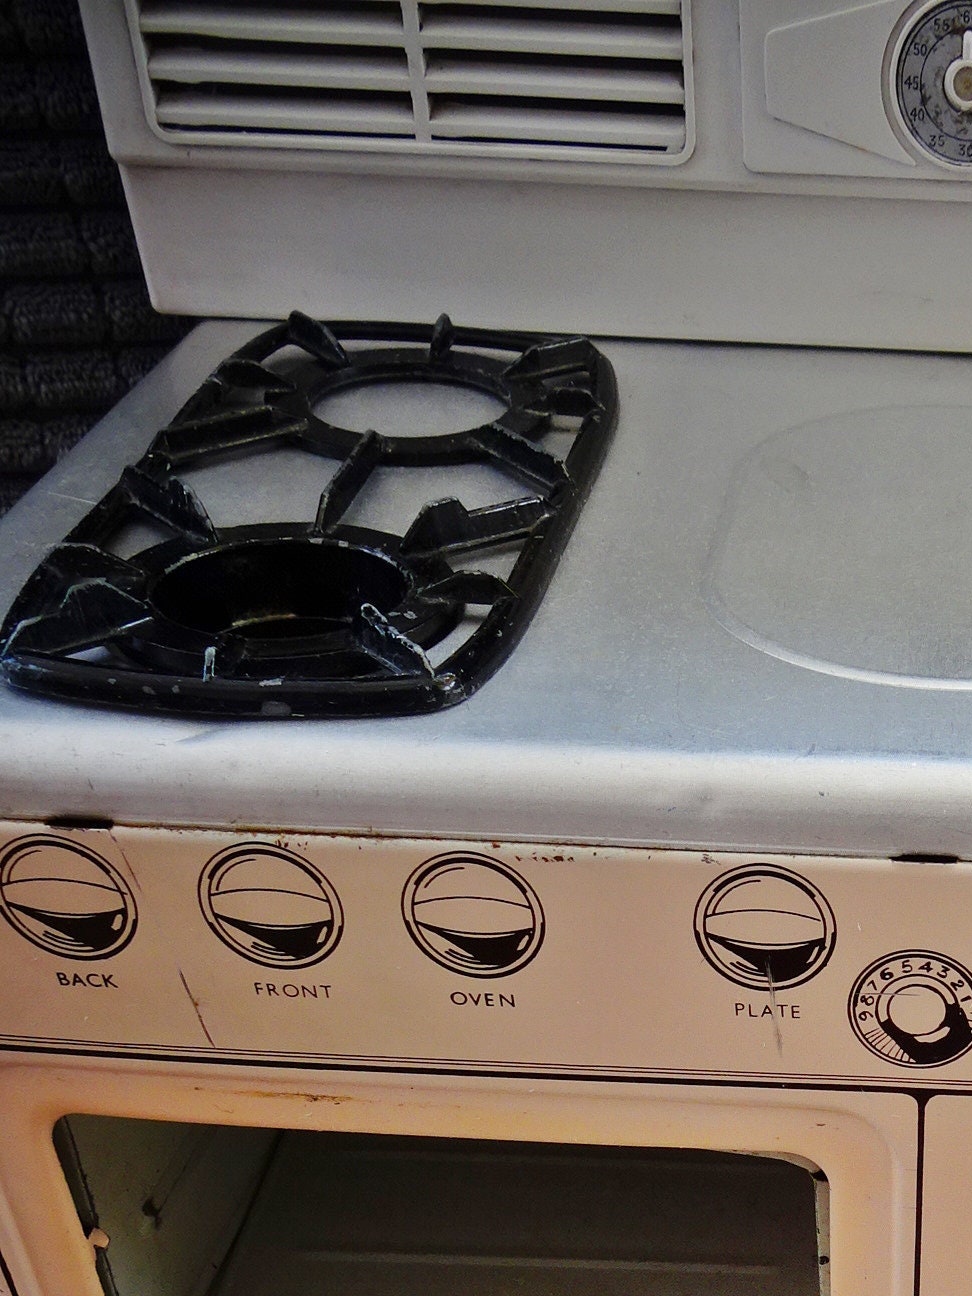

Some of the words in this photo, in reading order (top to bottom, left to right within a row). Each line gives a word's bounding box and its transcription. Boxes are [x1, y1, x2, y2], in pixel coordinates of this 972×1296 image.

[913, 43, 927, 56] 50
[904, 76, 919, 90] 45
[910, 107, 925, 121] 40
[929, 135, 945, 147] 35
[901, 959, 913, 973] 5
[918, 961, 933, 973] 4
[936, 965, 951, 979] 3
[56, 971, 119, 990] BACK
[879, 967, 894, 981] 6
[254, 981, 333, 1000] FRONT
[867, 980, 878, 991] 7
[950, 979, 965, 992] 2
[450, 991, 517, 1008] OVEN
[860, 994, 874, 1006] 8
[960, 995, 972, 1003] 1
[734, 1002, 802, 1019] PLATE
[858, 1010, 874, 1022] 9
